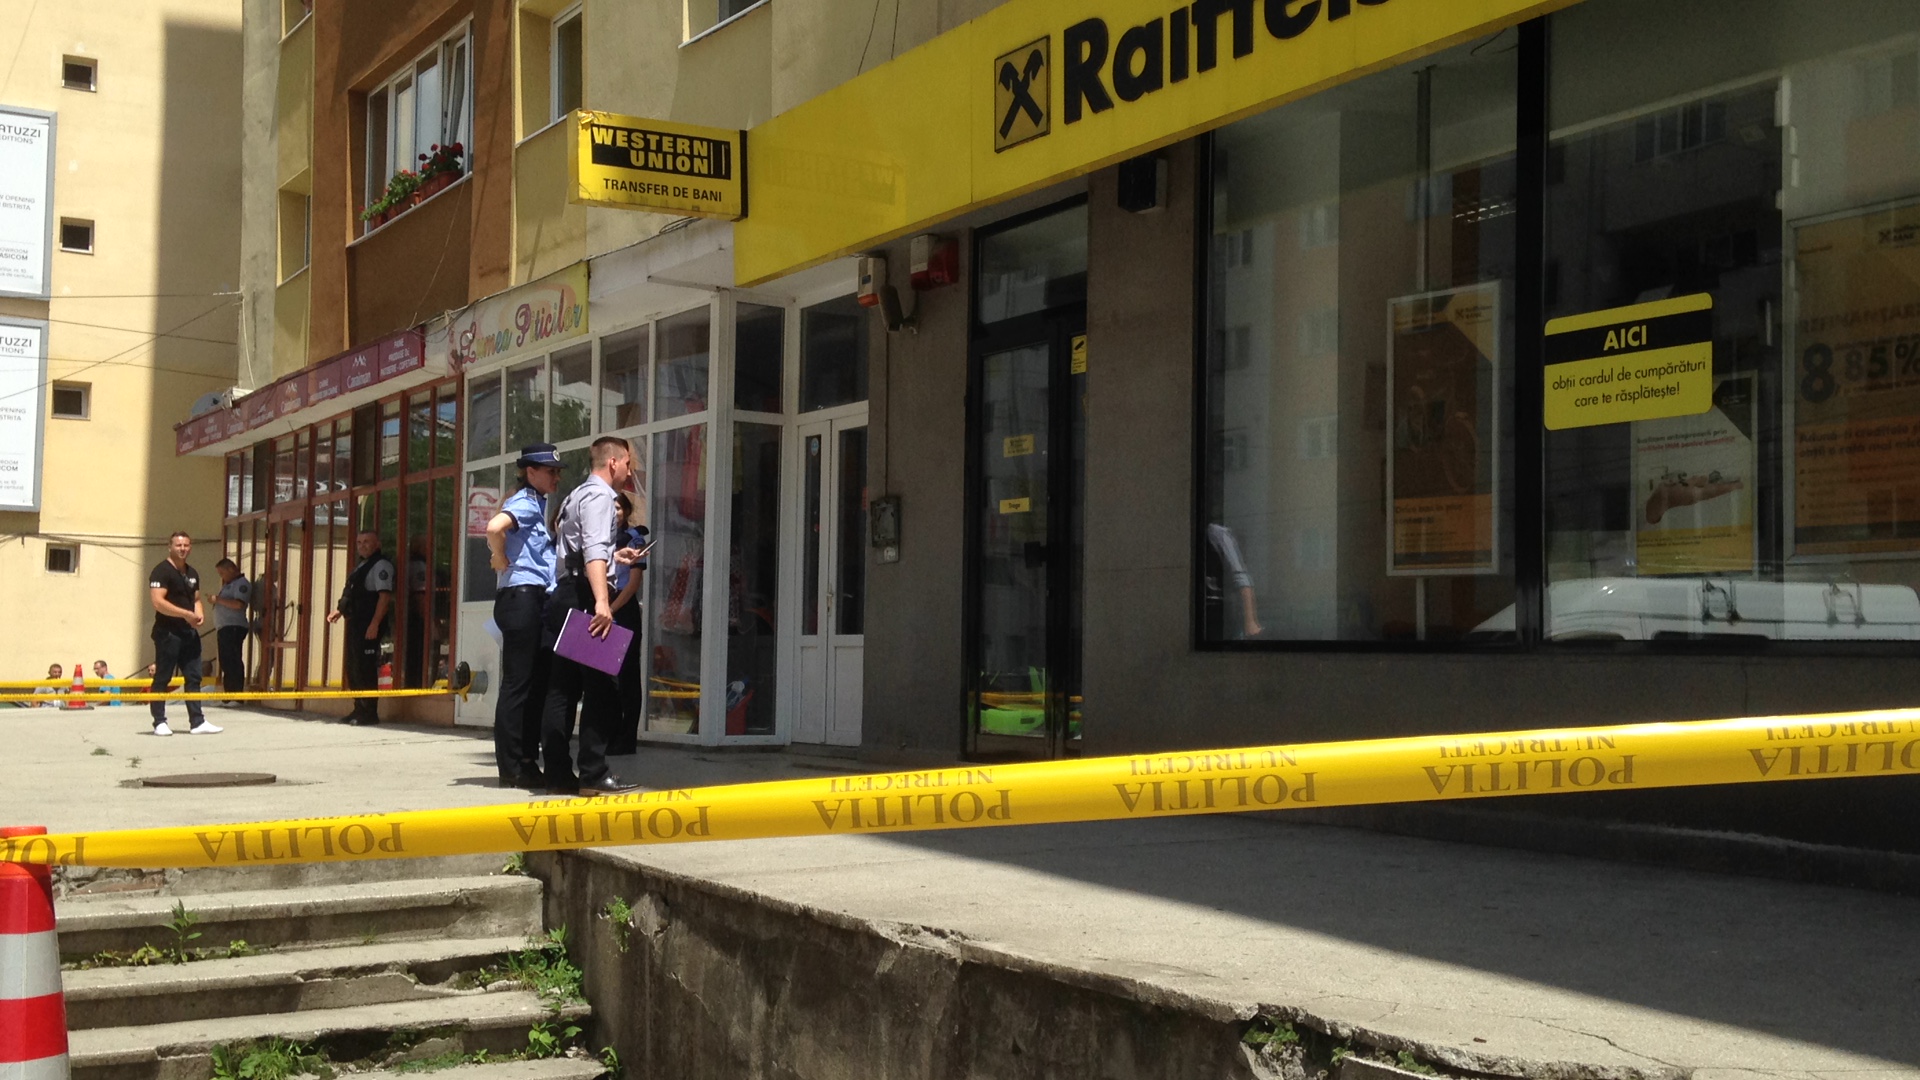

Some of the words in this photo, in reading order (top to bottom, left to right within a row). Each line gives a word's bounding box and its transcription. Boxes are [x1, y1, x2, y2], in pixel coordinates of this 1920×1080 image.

[592, 127, 708, 157] WESTERN
[630, 150, 708, 174] UNION
[603, 178, 669, 196] TRANSFER
[673, 186, 689, 198] DE
[693, 188, 722, 202] BANI
[1603, 325, 1647, 351] AICI
[1579, 368, 1613, 386] cardul
[1617, 366, 1631, 381] de
[1634, 357, 1706, 379] cumpărături
[1574, 395, 1599, 407] care
[1602, 392, 1612, 403] te
[1131, 752, 1252, 776] TRECETI
[1260, 750, 1297, 768] NU
[831, 772, 950, 792] TRECETI
[957, 768, 994, 786] NU
[1424, 755, 1636, 796] POLITIA
[1113, 772, 1317, 813] POLITIA
[811, 789, 1012, 831] POLITIA
[507, 805, 711, 846] POLITIA
[193, 822, 405, 863] POLITIA
